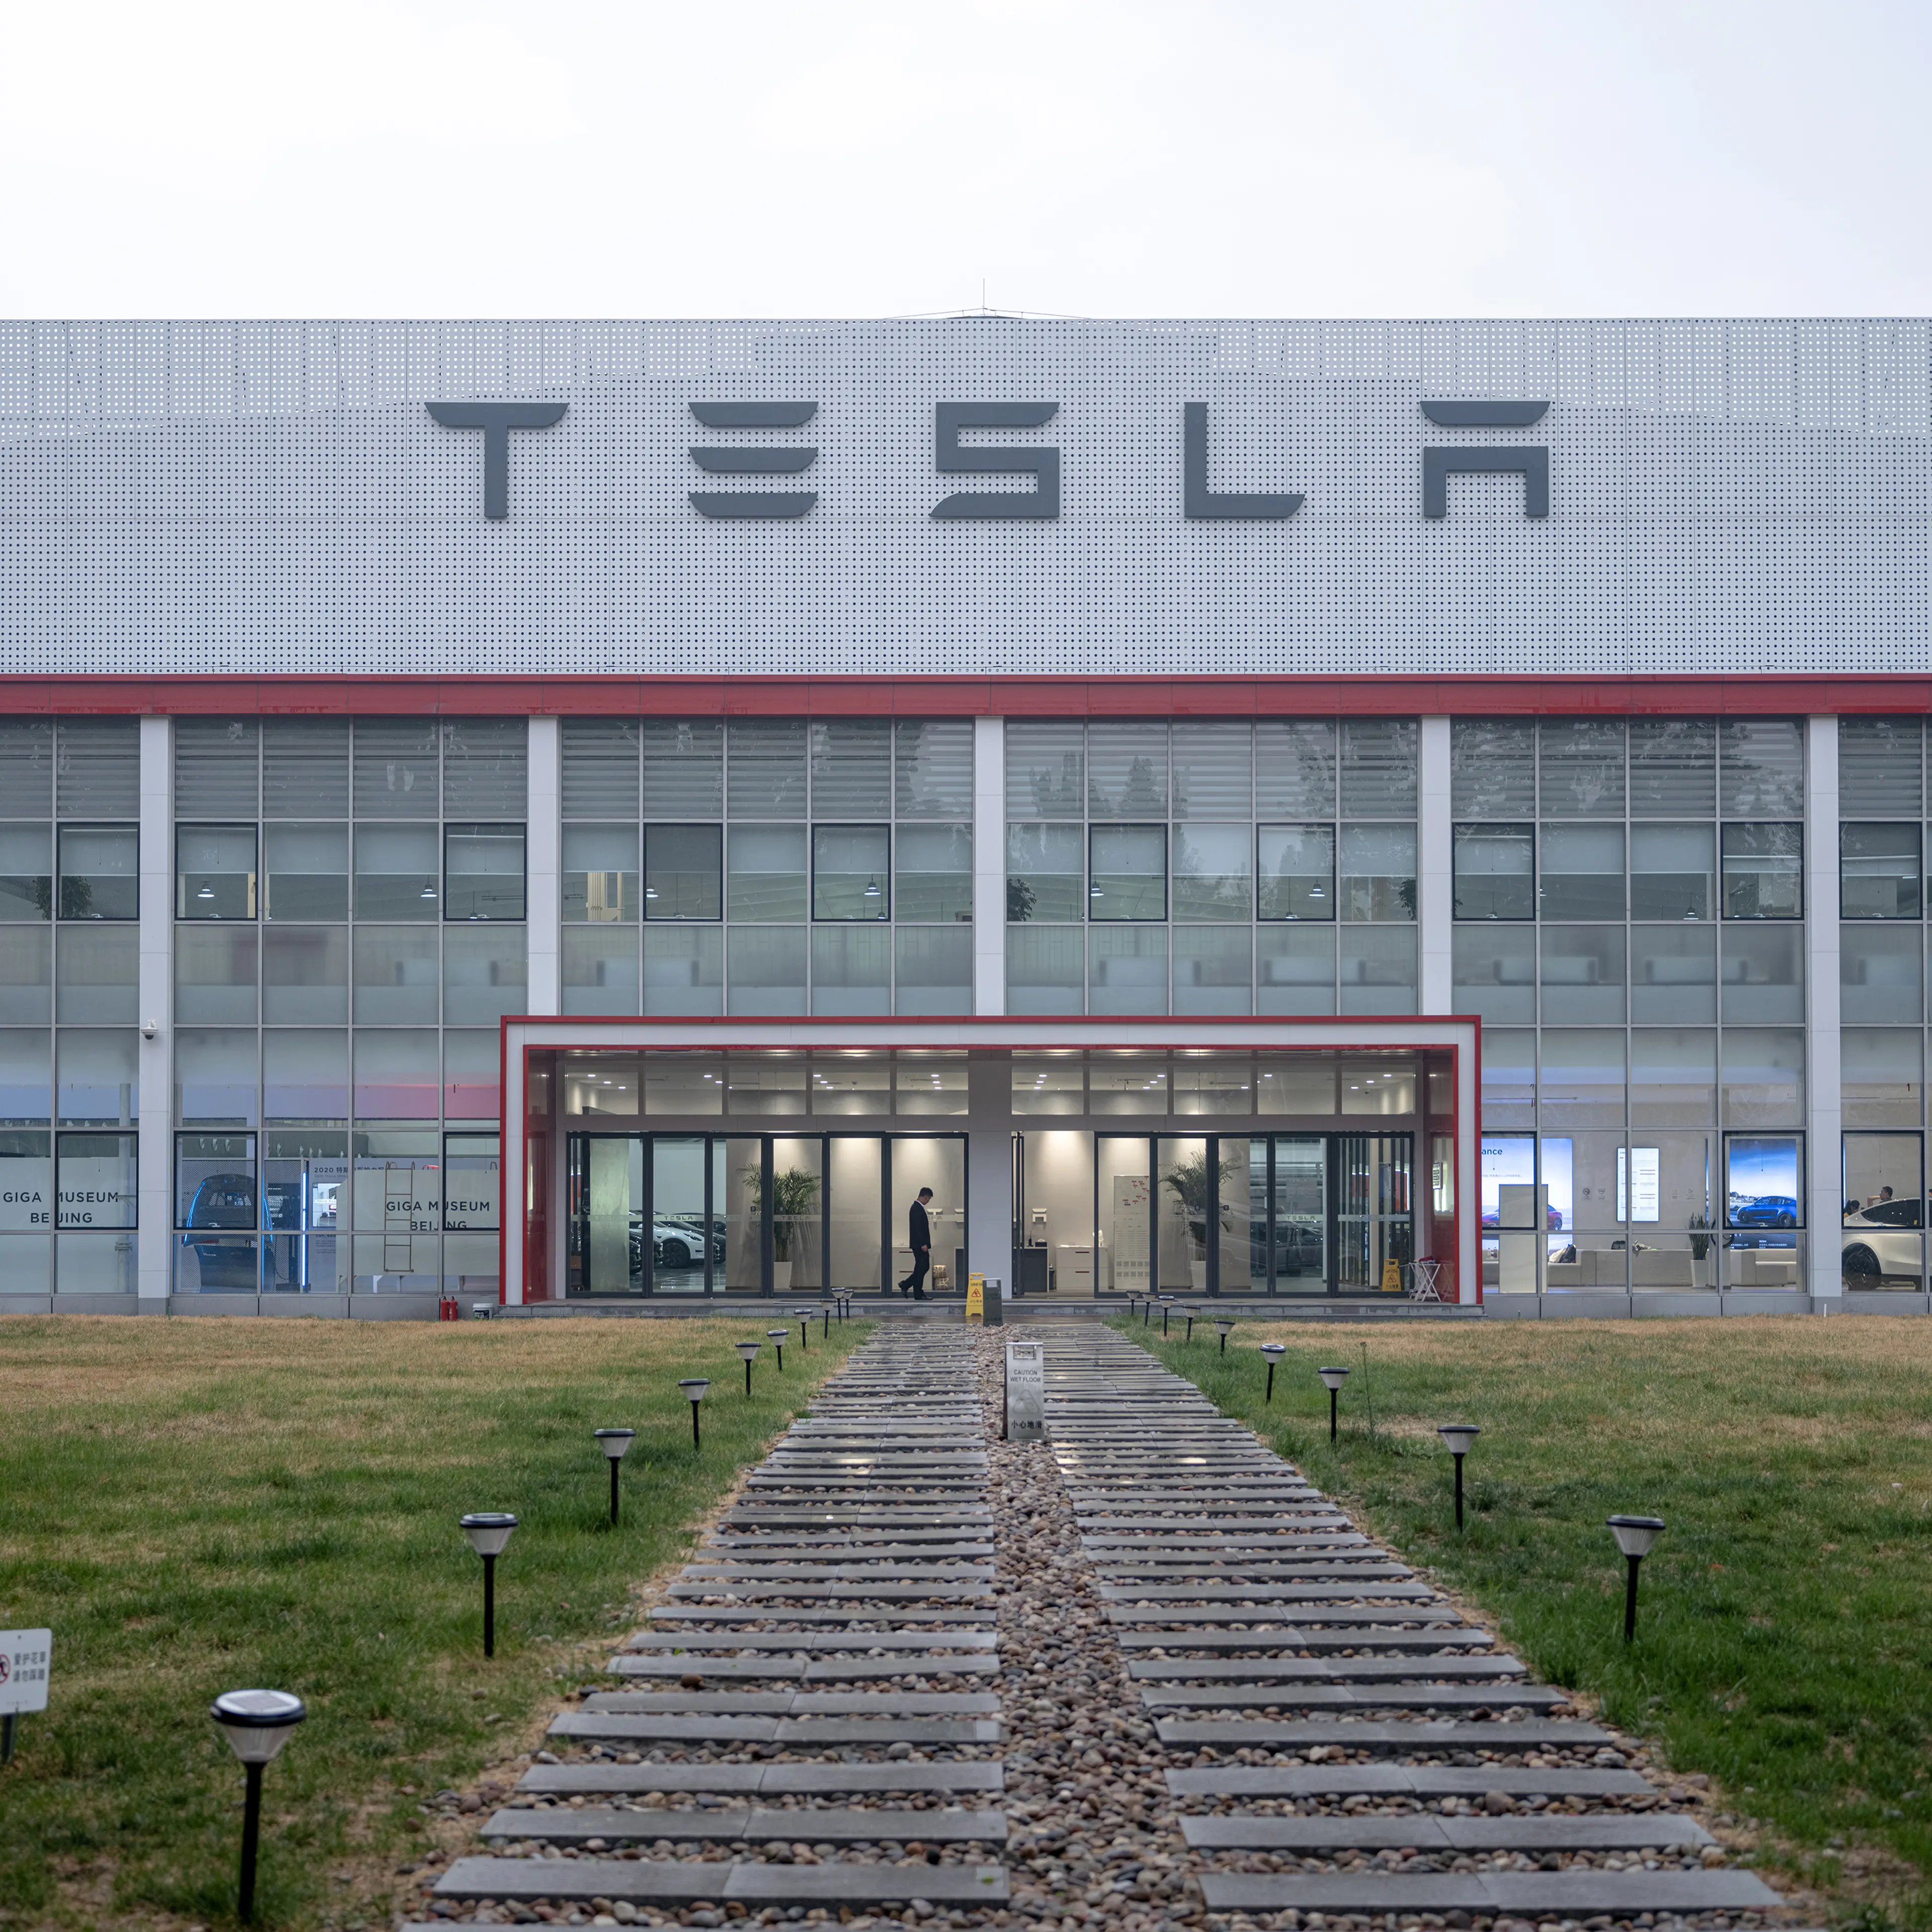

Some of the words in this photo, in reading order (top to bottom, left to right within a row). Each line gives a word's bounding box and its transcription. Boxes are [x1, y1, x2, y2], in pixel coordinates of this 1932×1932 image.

[424, 401, 1551, 518] TESLA
[3, 1192, 42, 1202] GIGA
[386, 1201, 422, 1211] GIGA
[31, 1213, 92, 1223] BEJING
[411, 1221, 466, 1231] BEIJNG
[1011, 1420, 1042, 1430] 小心地滑
